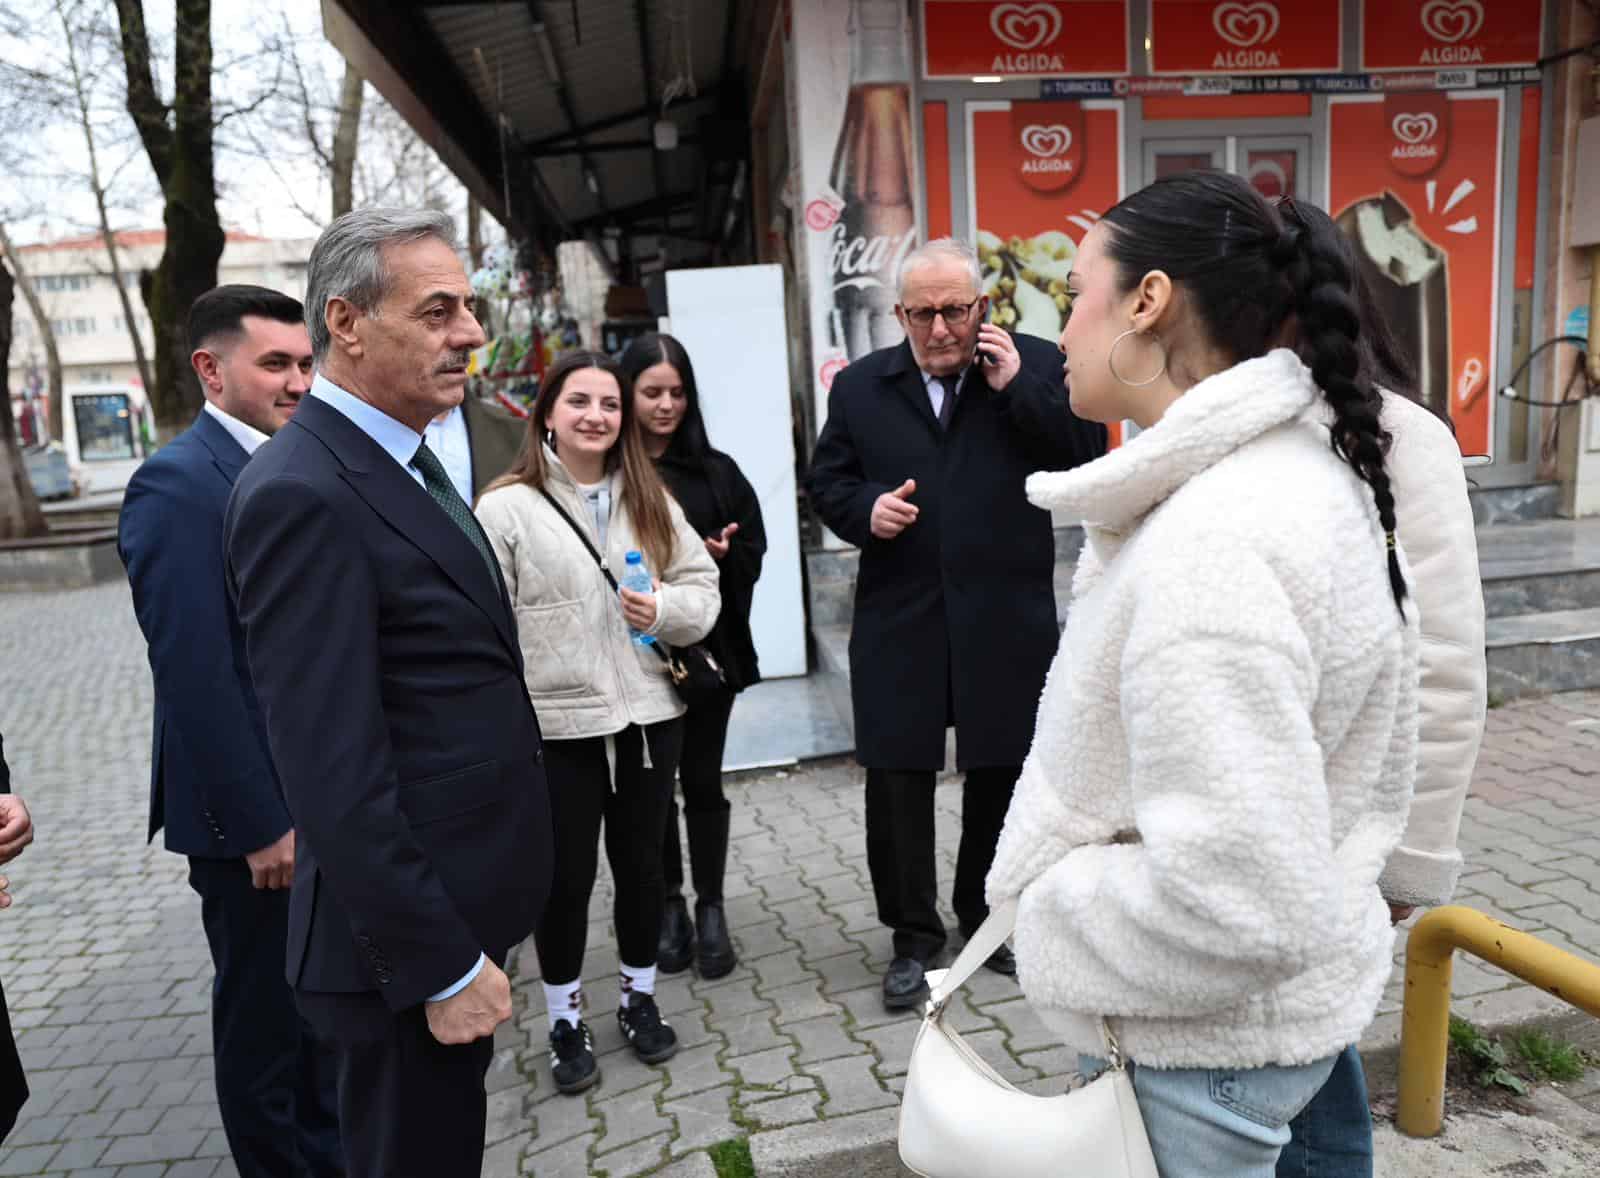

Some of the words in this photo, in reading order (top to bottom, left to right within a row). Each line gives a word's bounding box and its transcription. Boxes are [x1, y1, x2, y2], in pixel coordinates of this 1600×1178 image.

[992, 54, 1063, 72] ALGIDA
[1213, 51, 1280, 68] ALGIDA
[1420, 47, 1483, 64] ALGIDA
[1392, 144, 1437, 158] ALGIDA
[1022, 159, 1072, 173] ALGIDA
